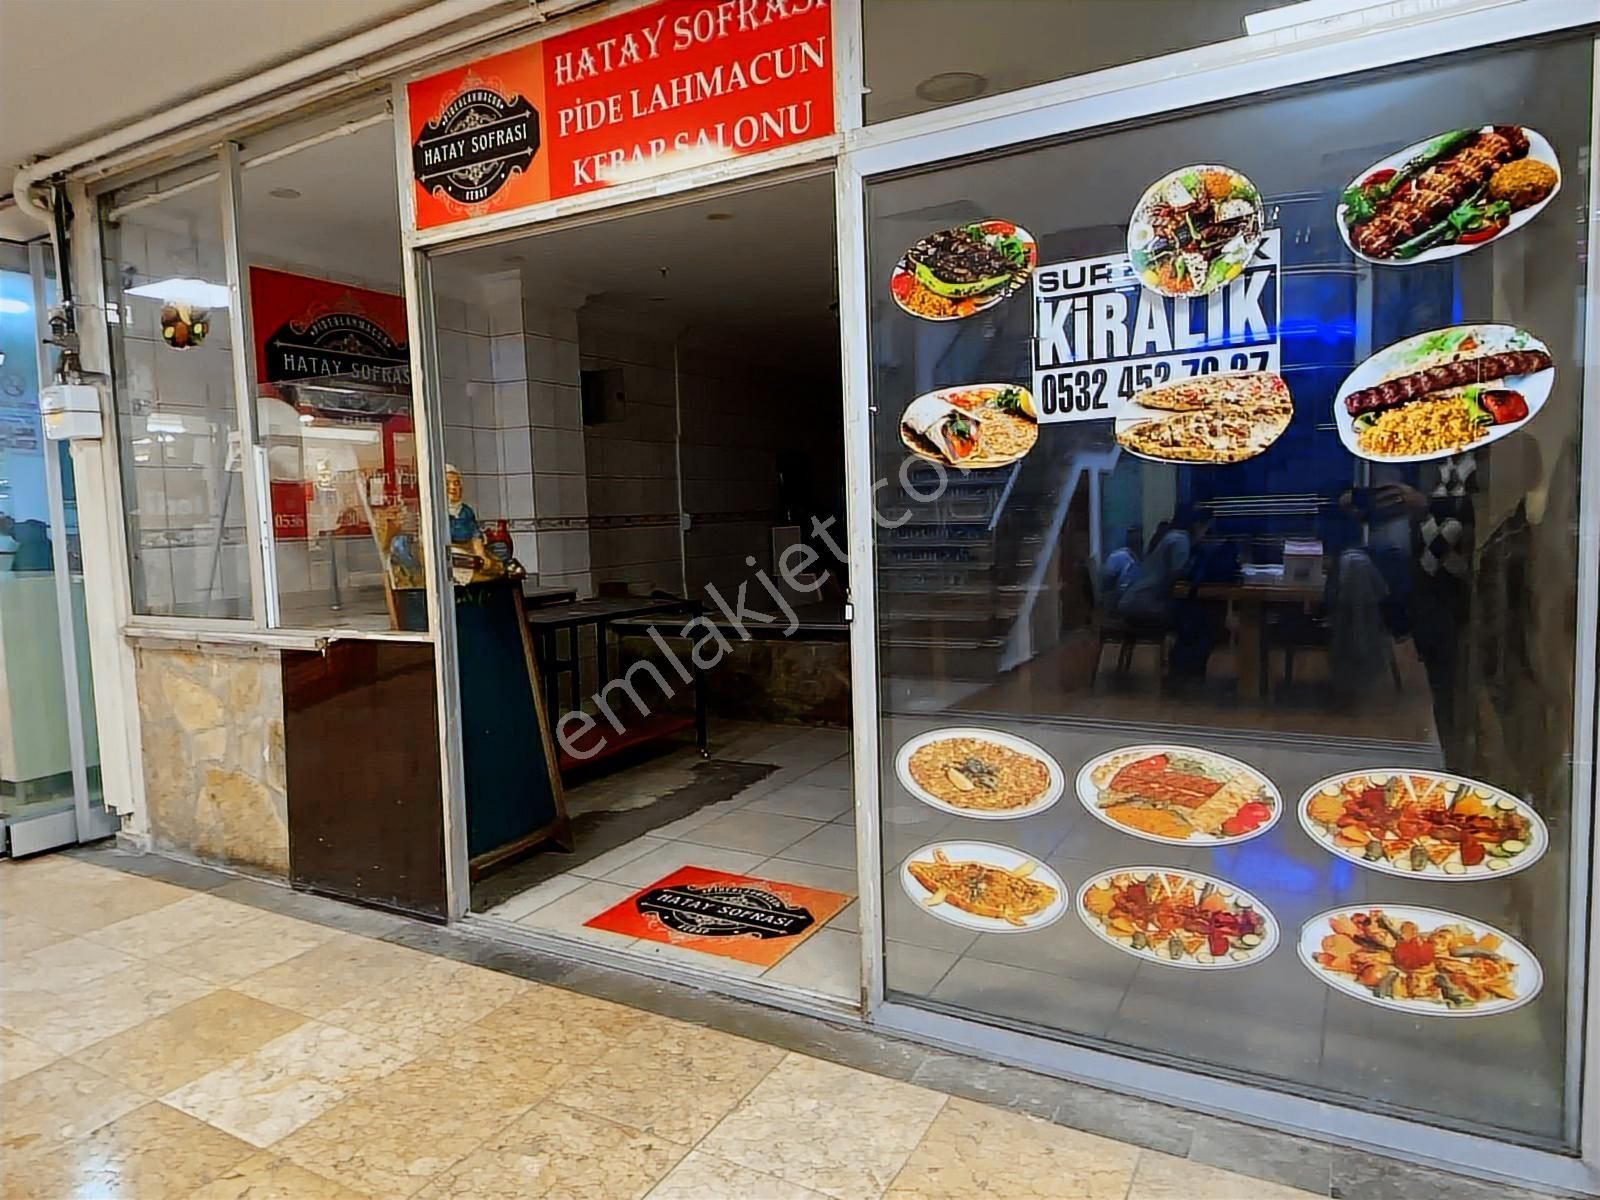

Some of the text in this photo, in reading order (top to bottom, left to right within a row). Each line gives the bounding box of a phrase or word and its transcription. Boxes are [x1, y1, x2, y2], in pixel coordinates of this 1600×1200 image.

[554, 0, 827, 87] HATAY SOFRA
[632, 36, 826, 119] LAHMACUN
[424, 123, 527, 166] HATAY SOFRASI
[284, 353, 411, 385] HATAY SOFRAS
[1041, 369, 1108, 415] 0532
[657, 894, 715, 910] HATAY
[718, 906, 794, 927] SOFRASI
